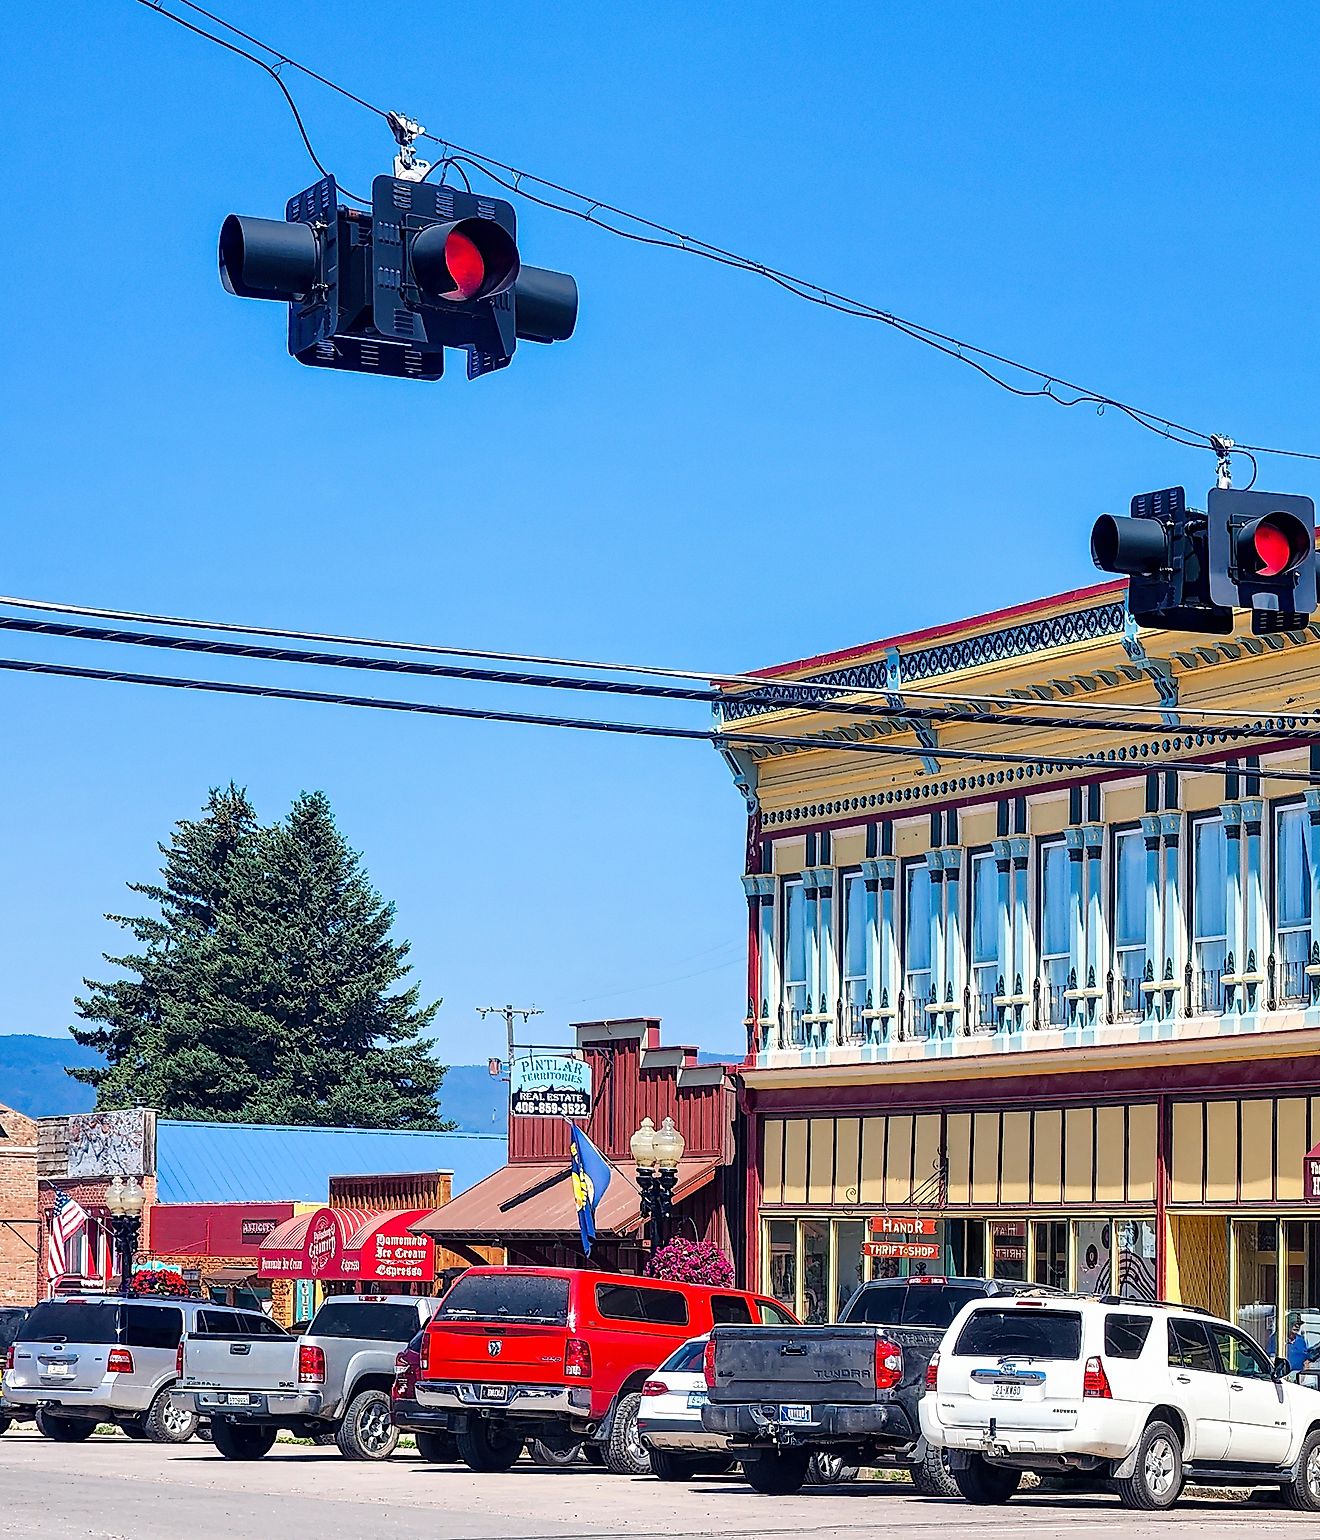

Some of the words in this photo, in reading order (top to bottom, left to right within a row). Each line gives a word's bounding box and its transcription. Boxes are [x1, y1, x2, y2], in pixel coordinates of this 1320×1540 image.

[521, 1059, 583, 1075] PINTLAR
[521, 1071, 583, 1084] TERRITORIES
[520, 1092, 545, 1101] REAL
[546, 1093, 583, 1103] ESTATE
[1310, 1161, 1320, 1175] The
[375, 1246, 392, 1259] Ice
[394, 1247, 427, 1259] Cream
[869, 1244, 904, 1256] THRIFT
[907, 1245, 935, 1257] SHOP
[375, 1264, 423, 1277] Espresso
[814, 1369, 871, 1379] TUNDRA
